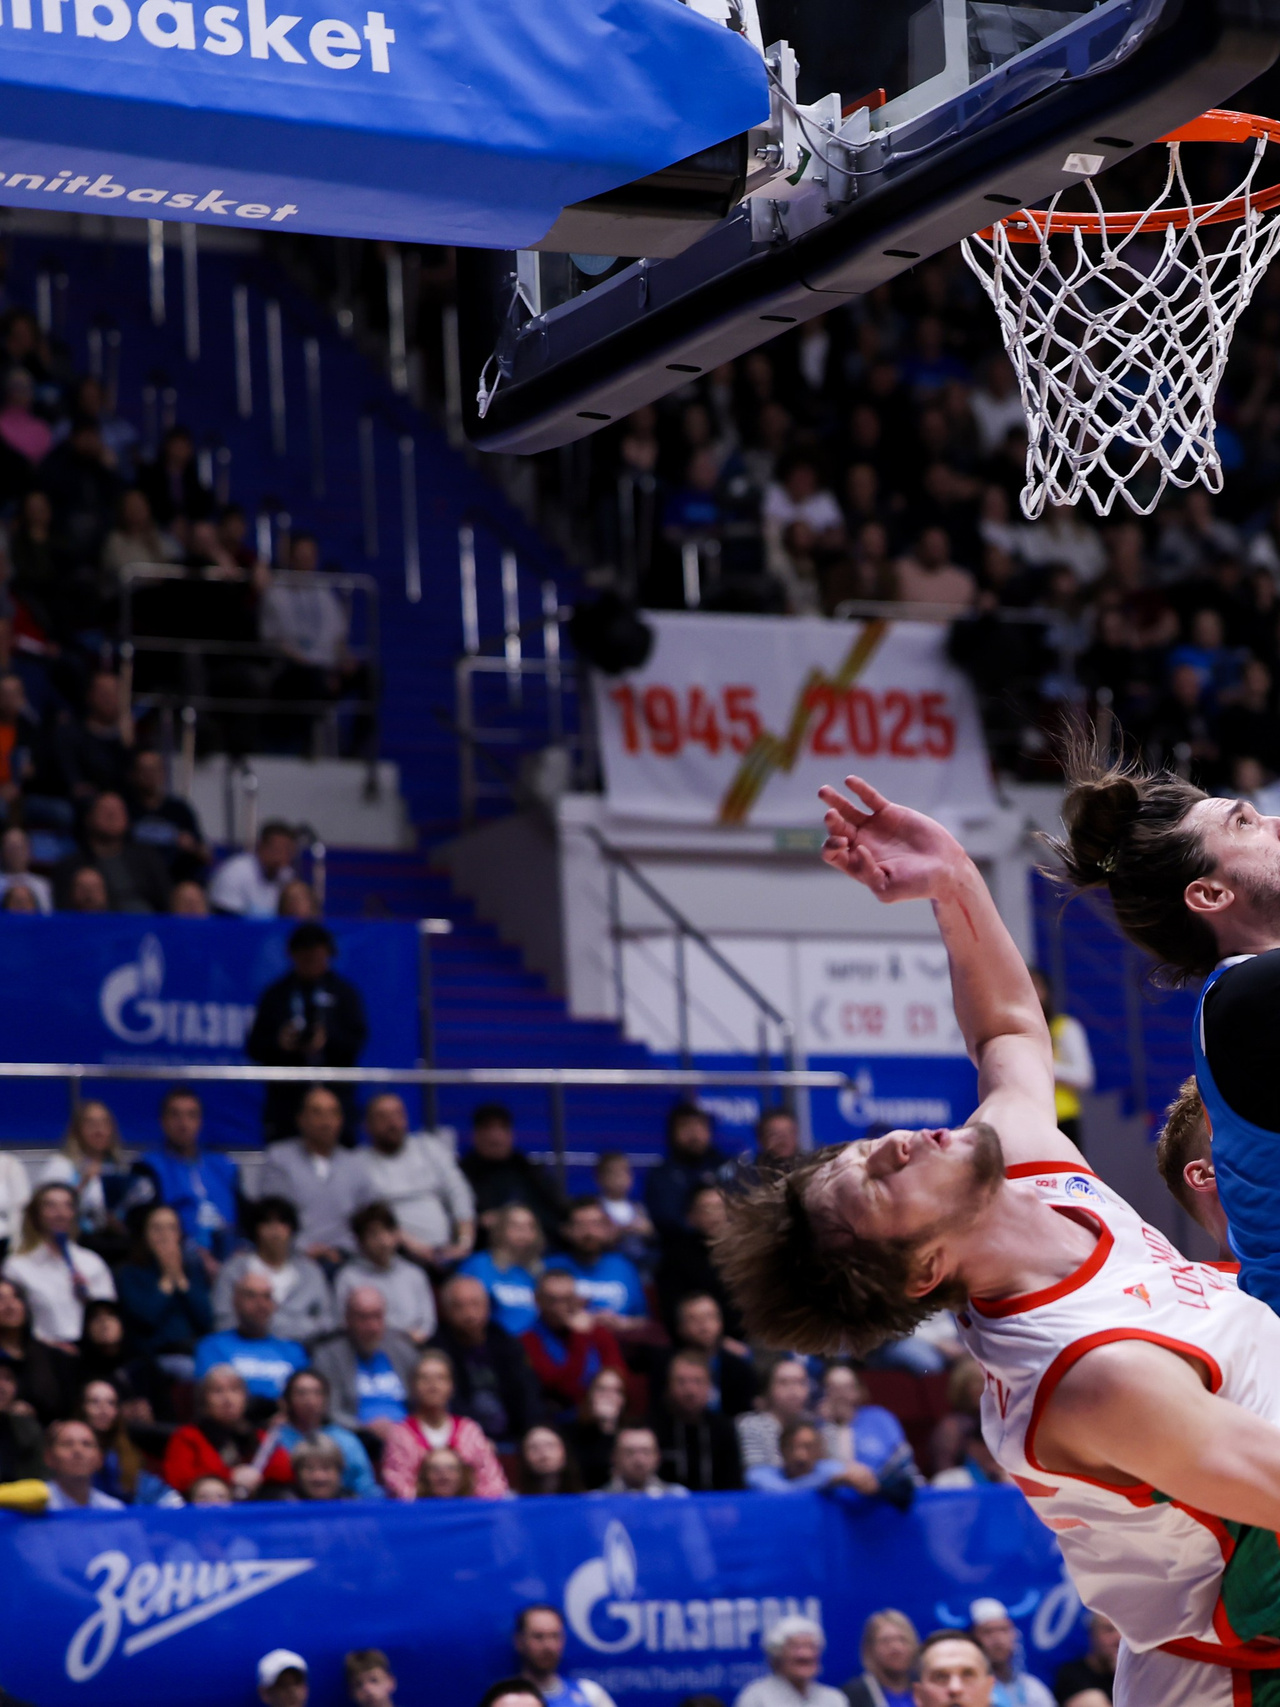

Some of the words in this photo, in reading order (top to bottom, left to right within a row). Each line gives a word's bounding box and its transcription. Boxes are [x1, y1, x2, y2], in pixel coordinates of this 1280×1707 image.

[611, 683, 763, 757] 1945
[804, 685, 956, 760] 2025
[65, 1549, 317, 1683] Зенит
